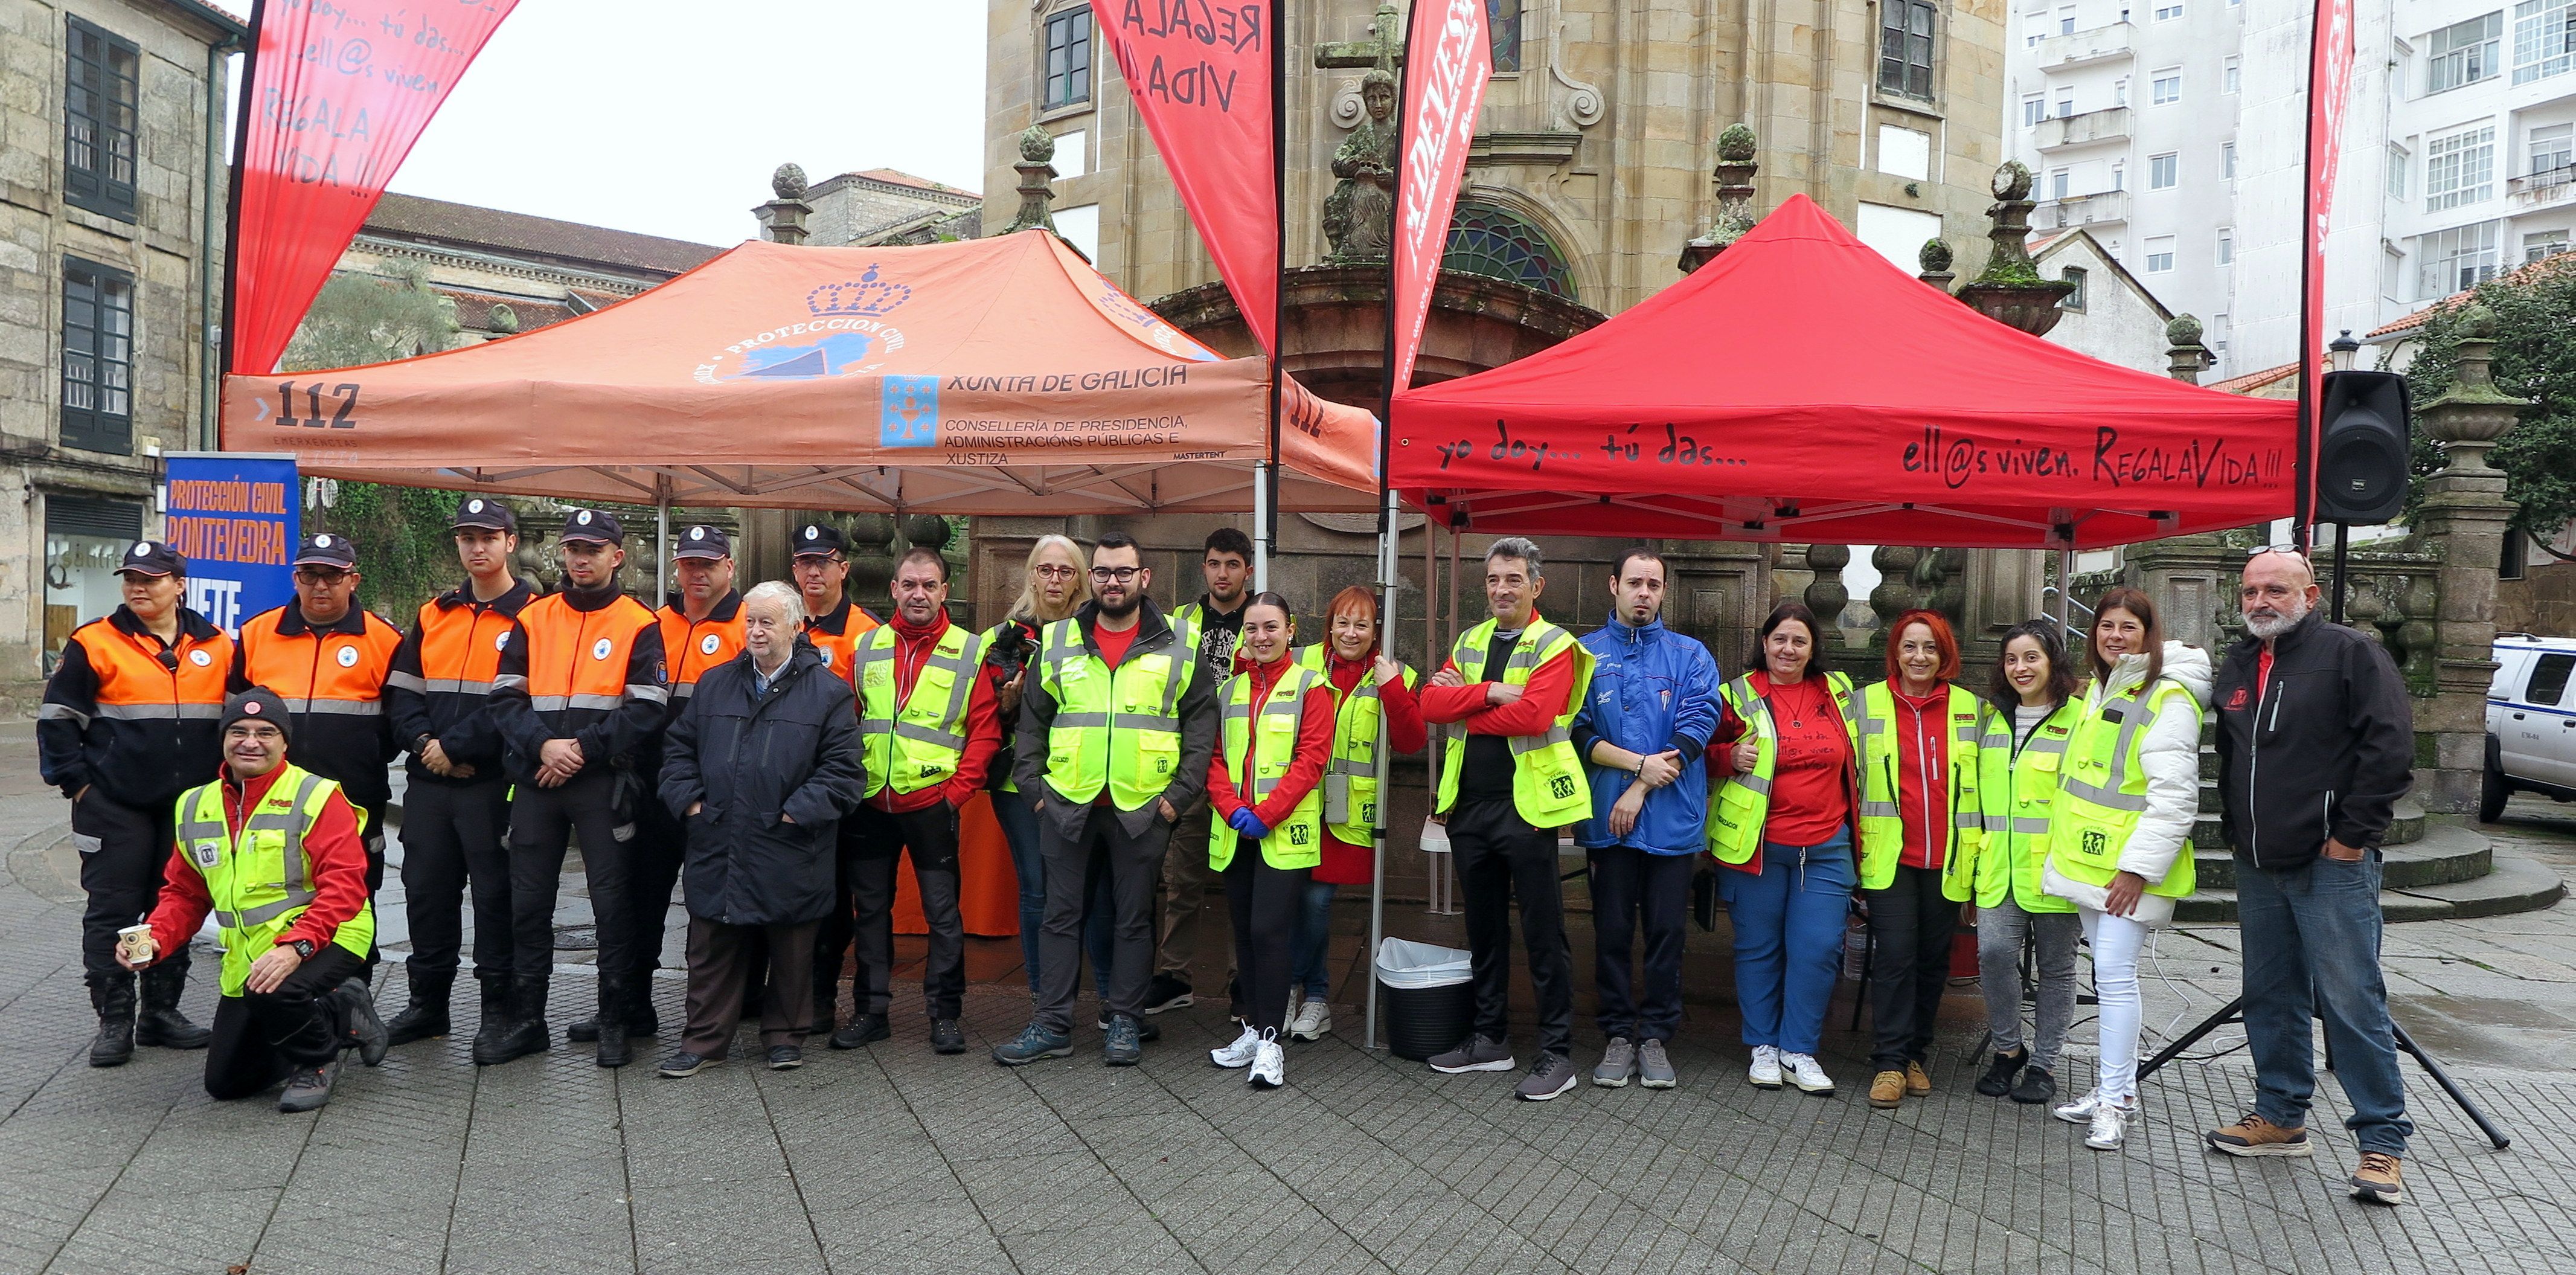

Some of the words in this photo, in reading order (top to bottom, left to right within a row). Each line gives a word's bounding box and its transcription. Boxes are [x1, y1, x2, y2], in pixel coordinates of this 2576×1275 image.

[379, 9, 405, 38] tú
[385, 65, 438, 94] viven
[263, 87, 370, 143] REGALA
[278, 147, 339, 188] VIDA
[725, 318, 885, 355] PROTECCION
[880, 327, 905, 355] CIVIL
[947, 374, 1036, 393] XUNTA
[1042, 374, 1072, 393] DE
[1080, 364, 1187, 391] GALICIA
[275, 381, 361, 429] 112
[944, 419, 1049, 432] CONSELLERÍA
[1053, 421, 1075, 432] DE
[1080, 415, 1188, 432] PRESIDENCIA,
[274, 436, 359, 448] EMERXENCIAS
[944, 434, 1082, 449] ADMINISTRACIÓNS
[1088, 432, 1164, 447] PÚBLICAS
[1169, 432, 1179, 444] E
[1173, 451, 1226, 460] MASTERTENT
[1436, 439, 1472, 470] yo
[1490, 419, 1581, 470] doy...
[1600, 423, 1639, 463] tú
[1658, 423, 1748, 466] das...
[1903, 424, 1987, 489] ell@s
[1997, 438, 2079, 477] viven.
[946, 452, 1008, 465] XUSTIZA
[170, 474, 250, 513] PROTECCIÓN
[252, 482, 287, 515] CIVIL
[167, 515, 286, 566] PONTEVEDRA
